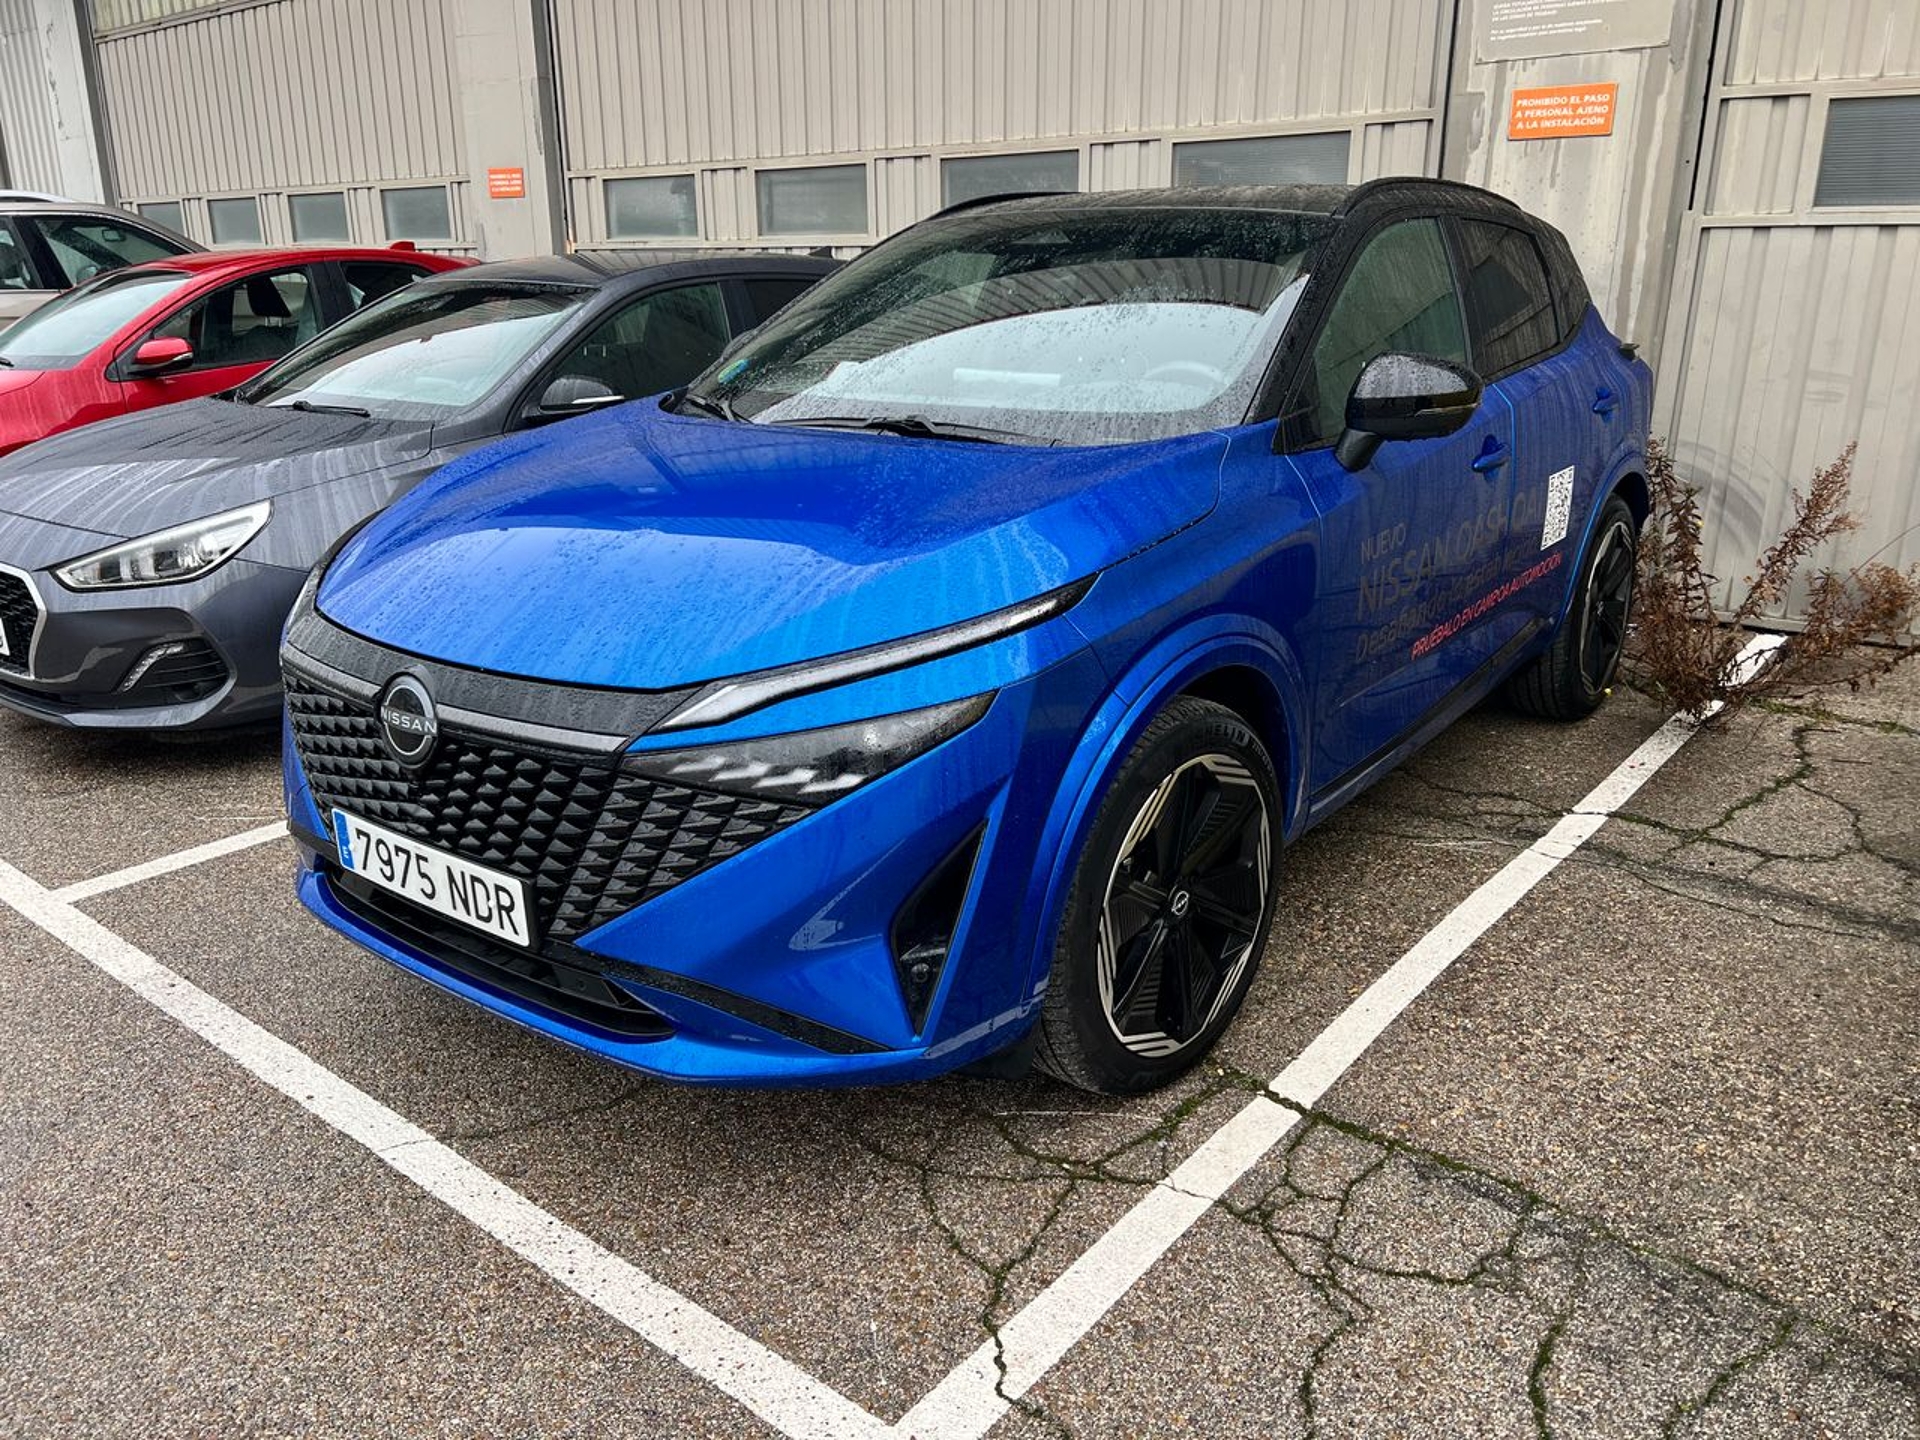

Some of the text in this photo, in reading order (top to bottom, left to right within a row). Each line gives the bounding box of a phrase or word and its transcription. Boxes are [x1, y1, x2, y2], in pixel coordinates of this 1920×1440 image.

[1515, 105, 1609, 118] A PERSONAL AJENO
[1516, 93, 1610, 108] PROHIBIDO EL PASO
[1516, 115, 1605, 129] A LA INSTALACIÓN
[1361, 522, 1407, 565] NUEVO
[1357, 530, 1451, 621] NISSAN
[381, 706, 437, 734] NISSAN
[355, 828, 520, 937] 7975 NDR
